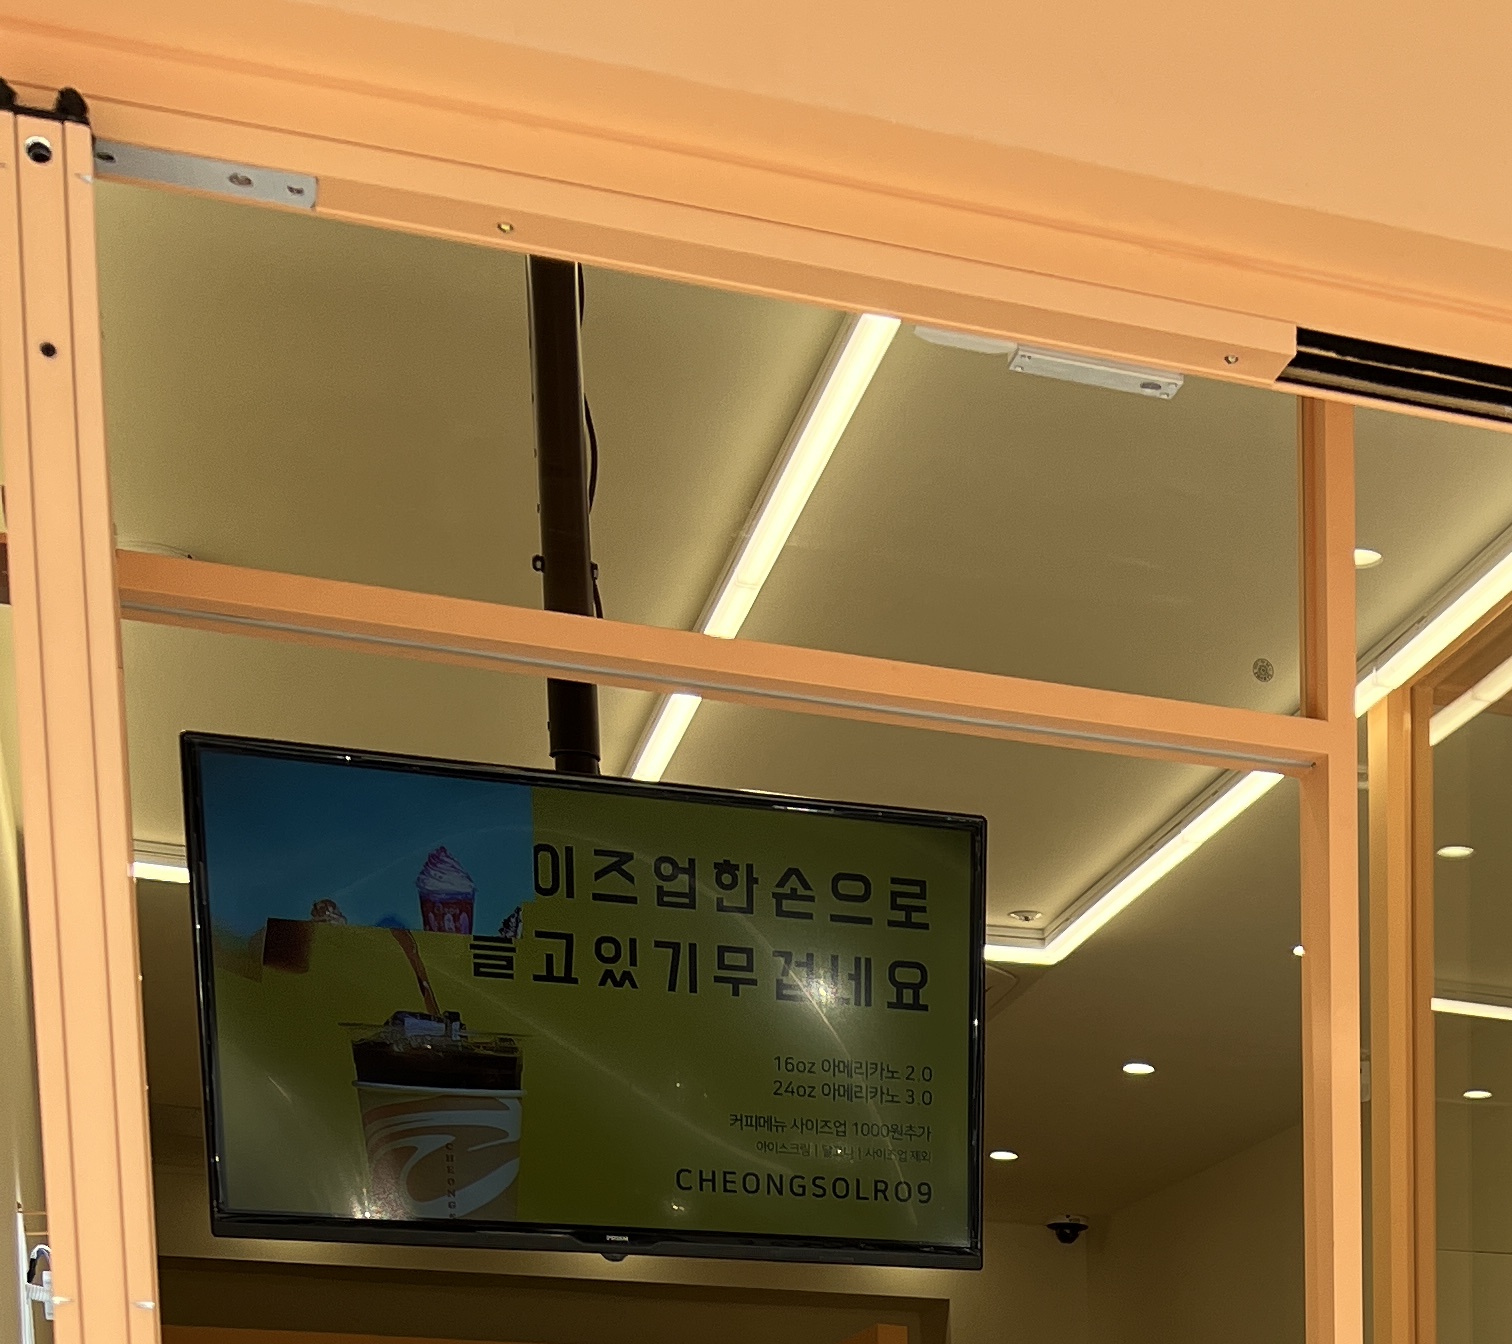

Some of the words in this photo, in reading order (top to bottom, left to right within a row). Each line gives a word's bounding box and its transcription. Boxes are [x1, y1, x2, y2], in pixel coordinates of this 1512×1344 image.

[773, 1056, 816, 1075] 16oz
[821, 1058, 901, 1081] 아메리카노
[905, 1065, 933, 1082] 2.0
[772, 1080, 816, 1099] 24oz
[821, 1082, 901, 1105] 아메리카노
[905, 1088, 933, 1106] 3.0
[730, 1113, 787, 1133] 커피메뉴
[790, 1116, 847, 1137] 사이즈업
[852, 1122, 932, 1142] 1000원추가
[756, 1141, 811, 1157] 아이스크림
[676, 1168, 933, 1204] CHEONGSOLRO9
